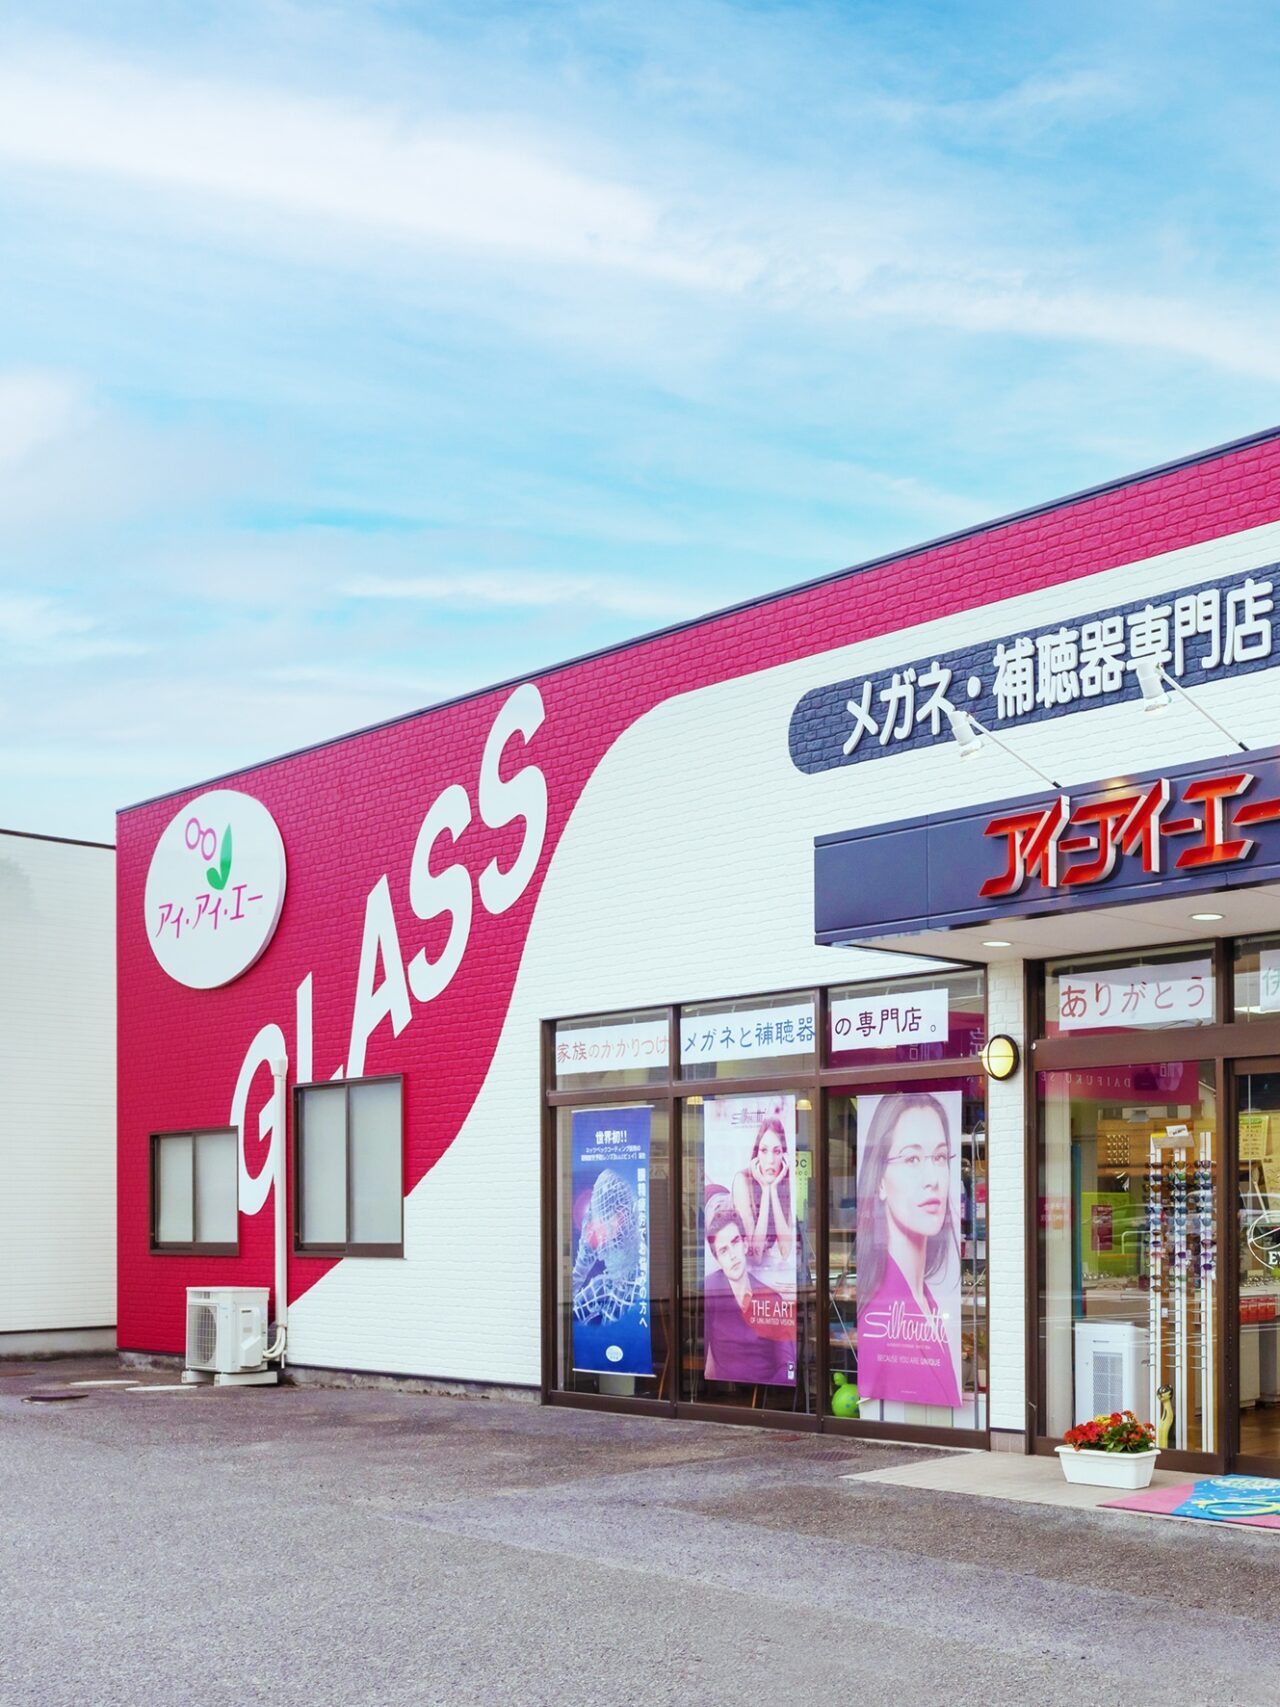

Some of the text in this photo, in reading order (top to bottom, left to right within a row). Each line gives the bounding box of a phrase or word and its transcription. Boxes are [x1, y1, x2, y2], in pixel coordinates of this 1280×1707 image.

[843, 578, 1274, 756] メガネ・補聴器専門店
[1060, 975, 1207, 1019] ありがとう
[556, 1035, 670, 1064] 家族のかかりつけ
[684, 1016, 816, 1054] メガネと補聴器
[751, 1299, 796, 1319] THE ART
[862, 1300, 950, 1346] Silhouette
